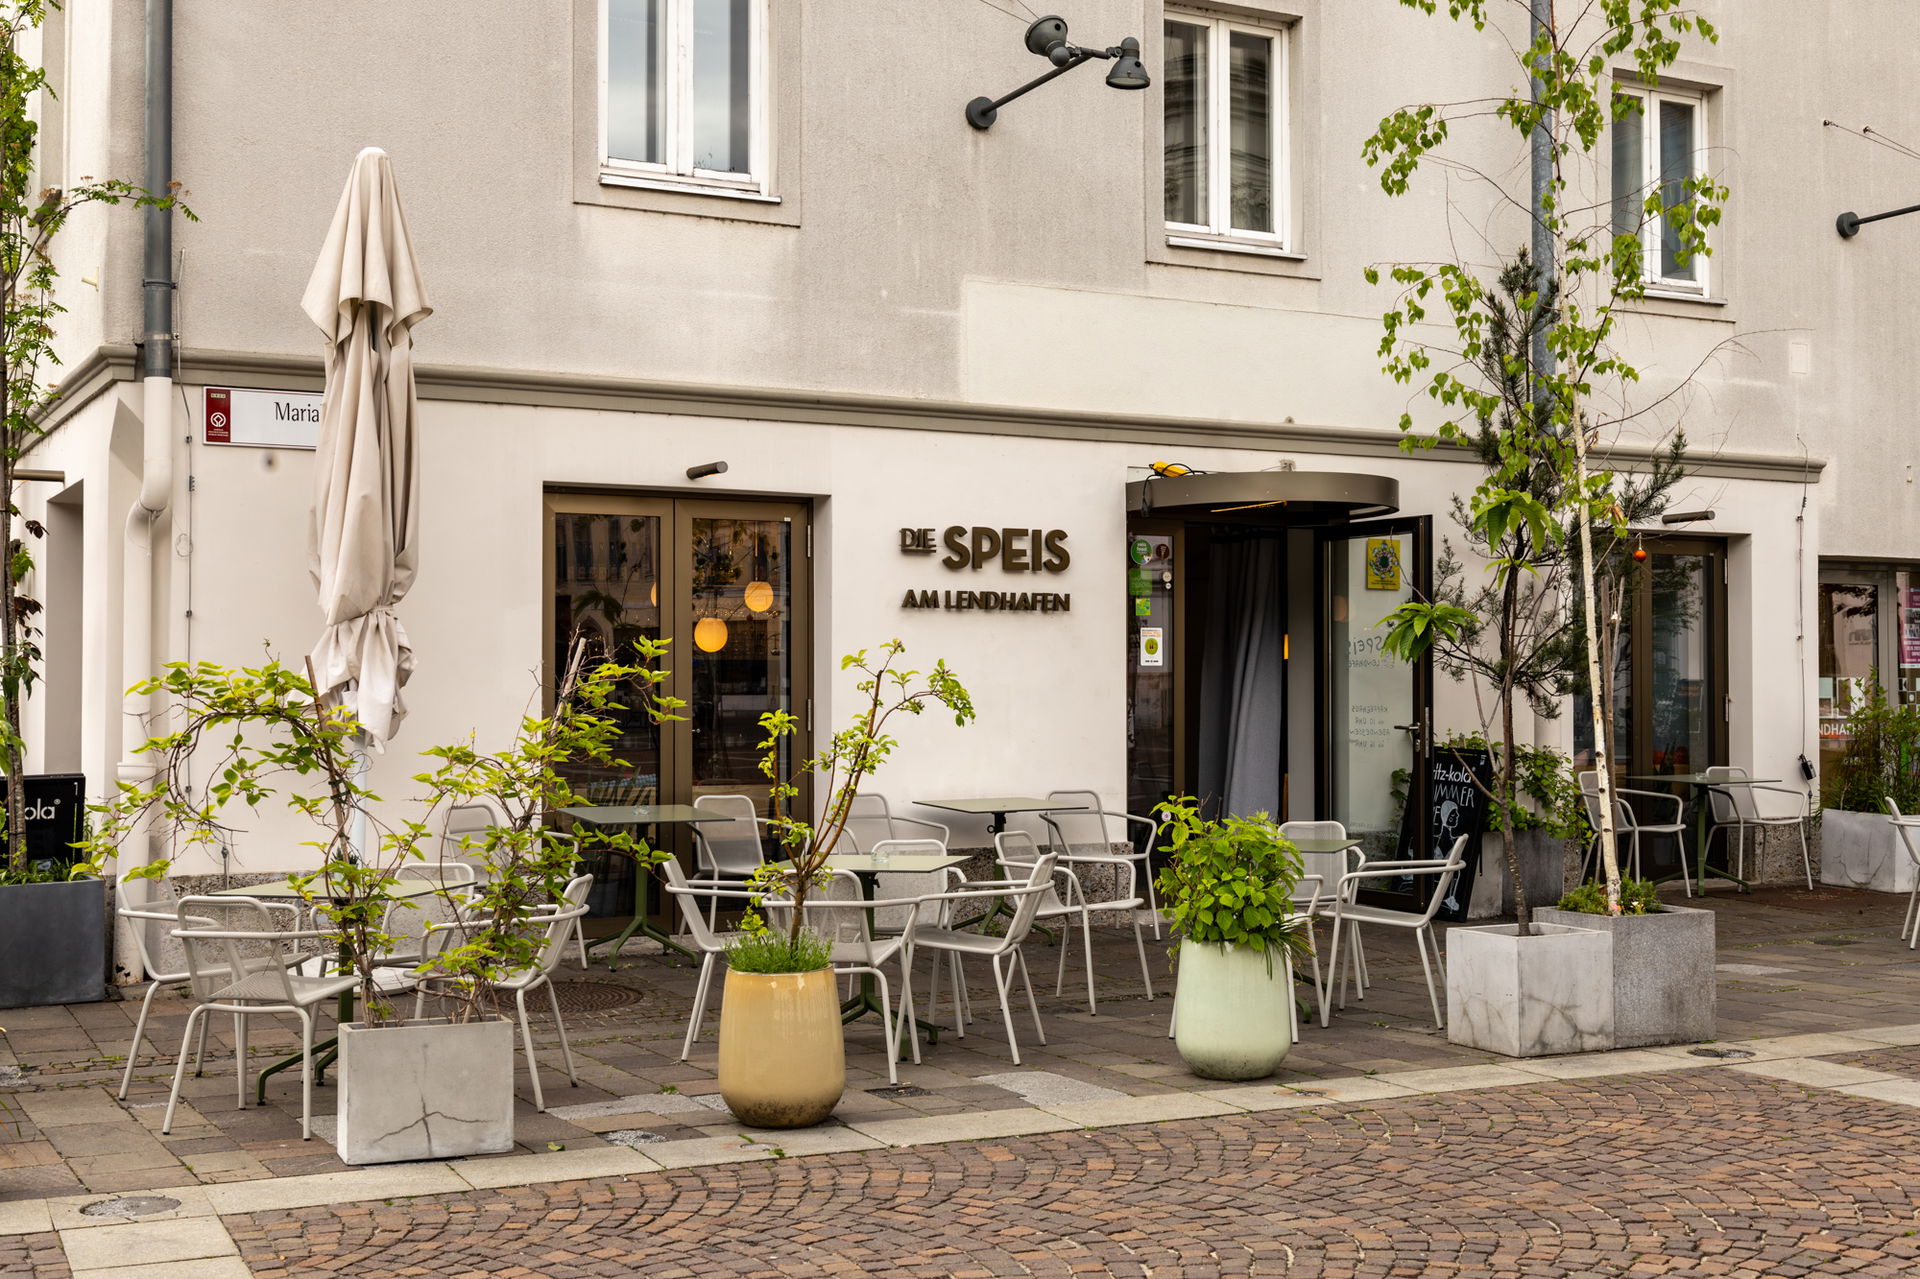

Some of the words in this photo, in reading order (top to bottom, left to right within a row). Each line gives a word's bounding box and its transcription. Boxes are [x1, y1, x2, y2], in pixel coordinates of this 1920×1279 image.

[274, 401, 320, 423] Maria
[899, 528, 937, 550] DIE
[942, 525, 1071, 573] SPEIS
[902, 589, 940, 609] AM
[944, 590, 1071, 612] LENDHAFEN
